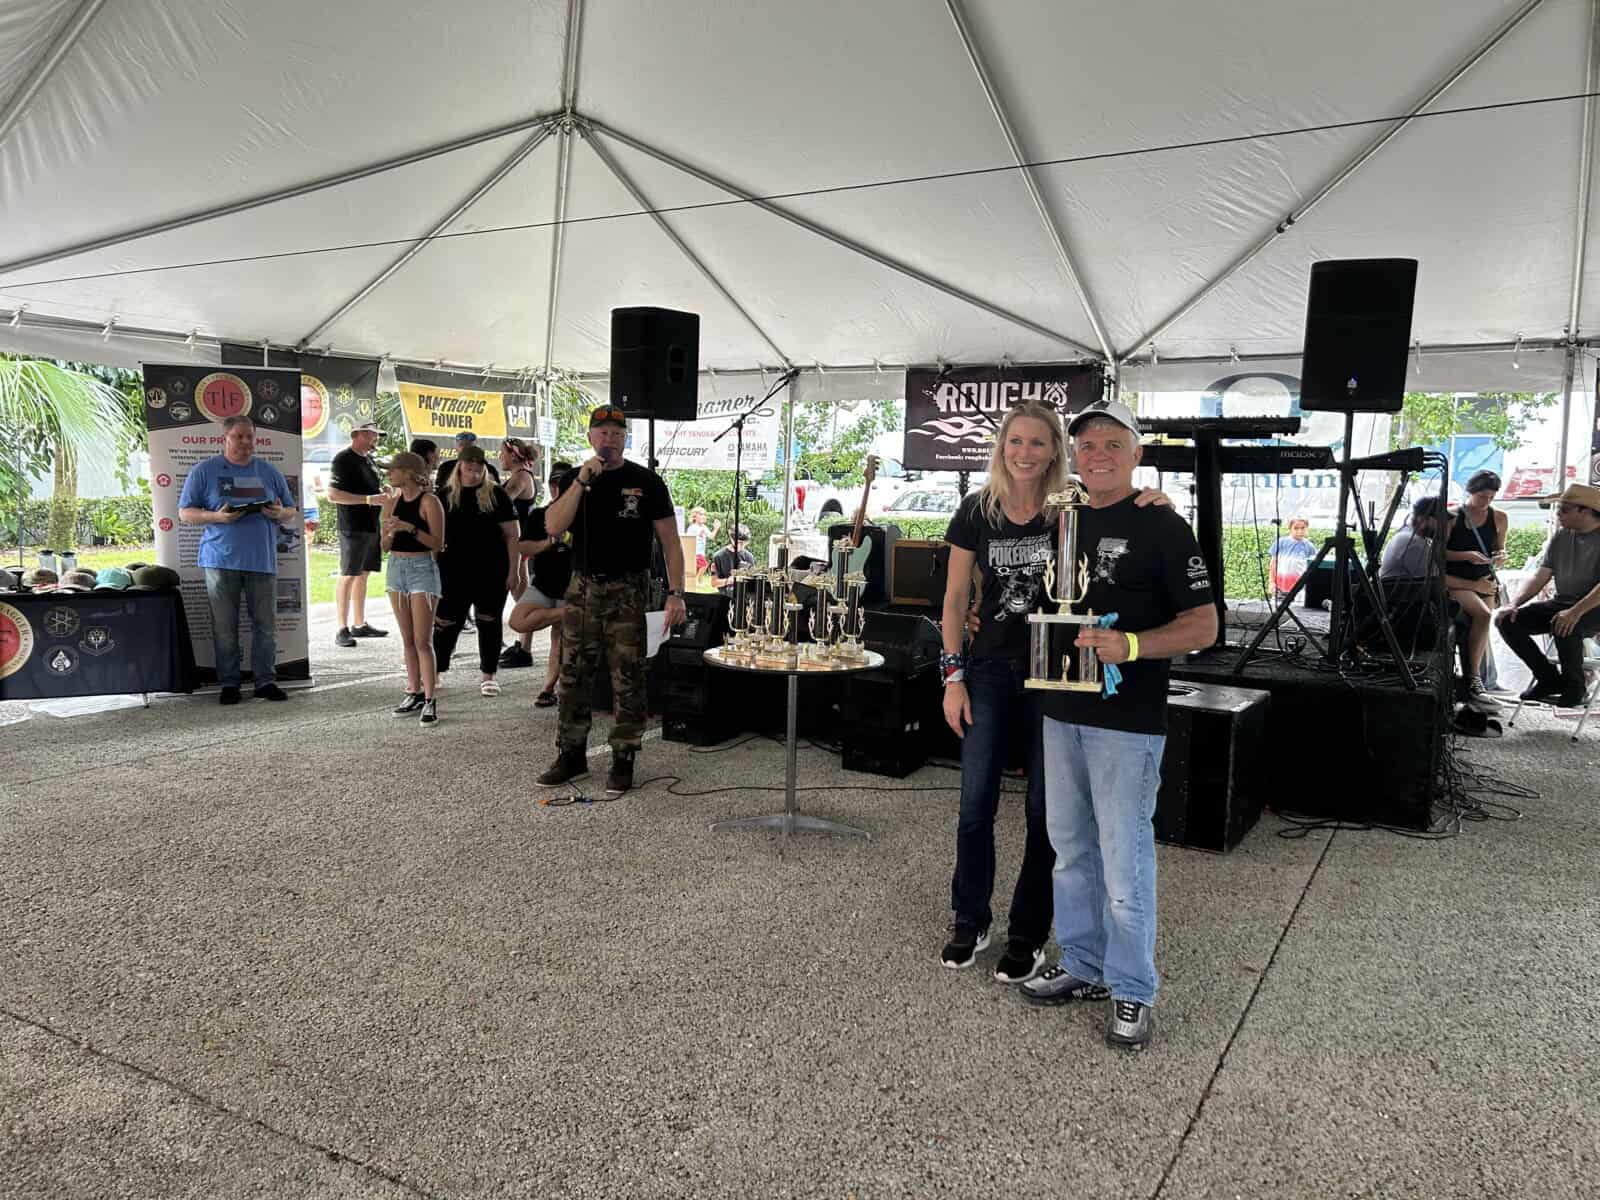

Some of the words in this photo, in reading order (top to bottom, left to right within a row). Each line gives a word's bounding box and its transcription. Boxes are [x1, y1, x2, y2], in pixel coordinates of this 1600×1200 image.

[418, 394, 487, 414] PANTROPIC
[431, 412, 473, 429] POWER
[508, 405, 535, 428] CAT
[182, 436, 207, 445] OUR
[656, 447, 708, 457] MERCURY
